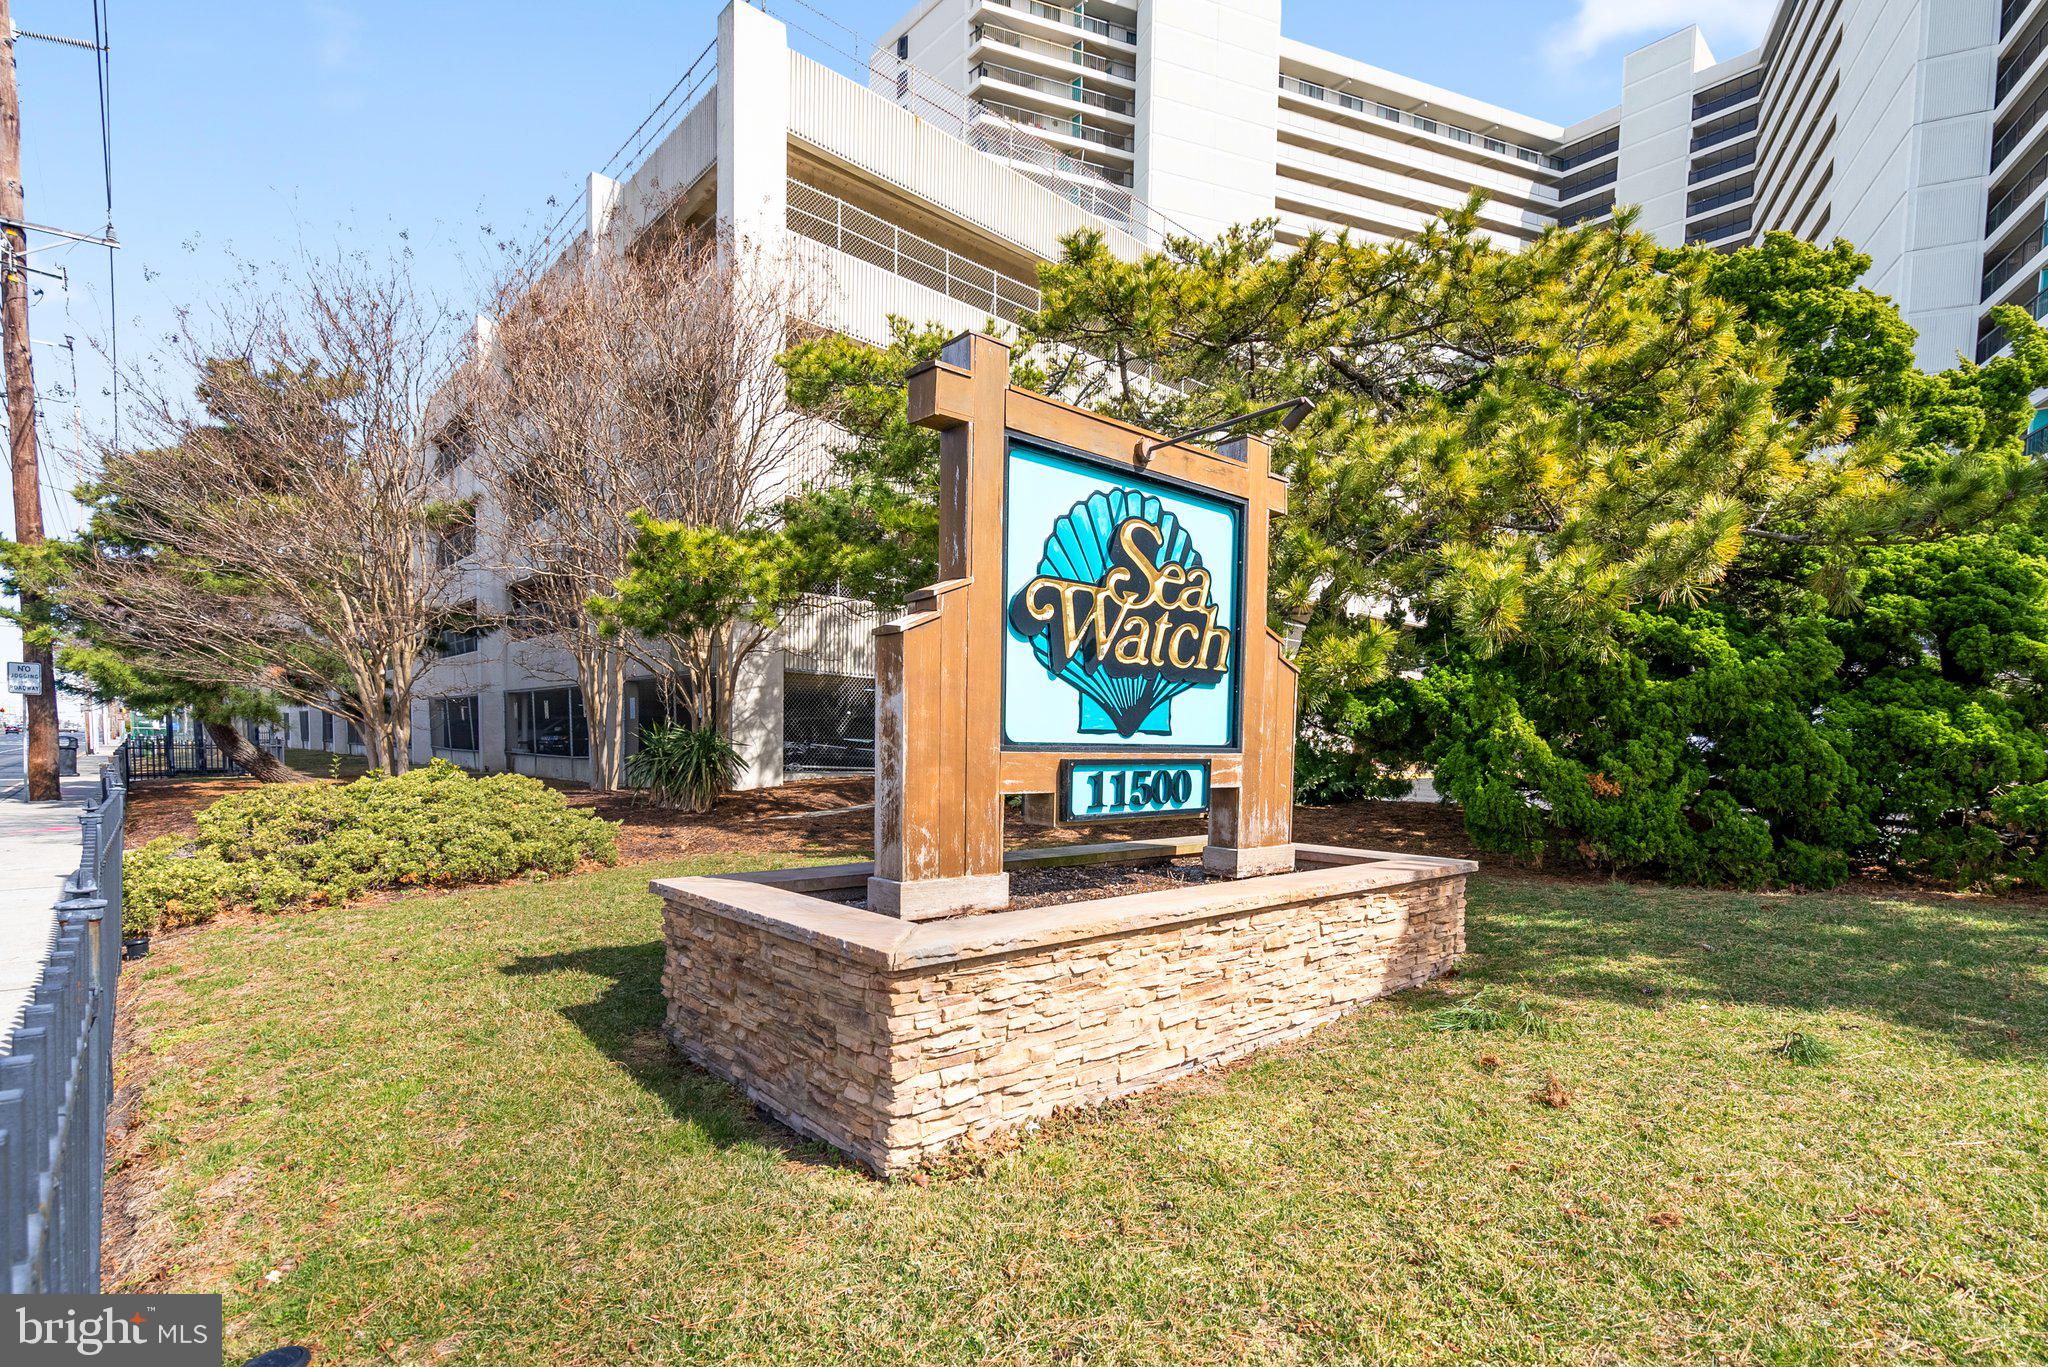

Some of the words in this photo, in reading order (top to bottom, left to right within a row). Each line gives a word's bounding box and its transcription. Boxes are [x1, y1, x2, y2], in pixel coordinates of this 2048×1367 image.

[1106, 518, 1213, 613] Sea
[1026, 577, 1231, 672] Watch
[1087, 769, 1192, 809] 11500
